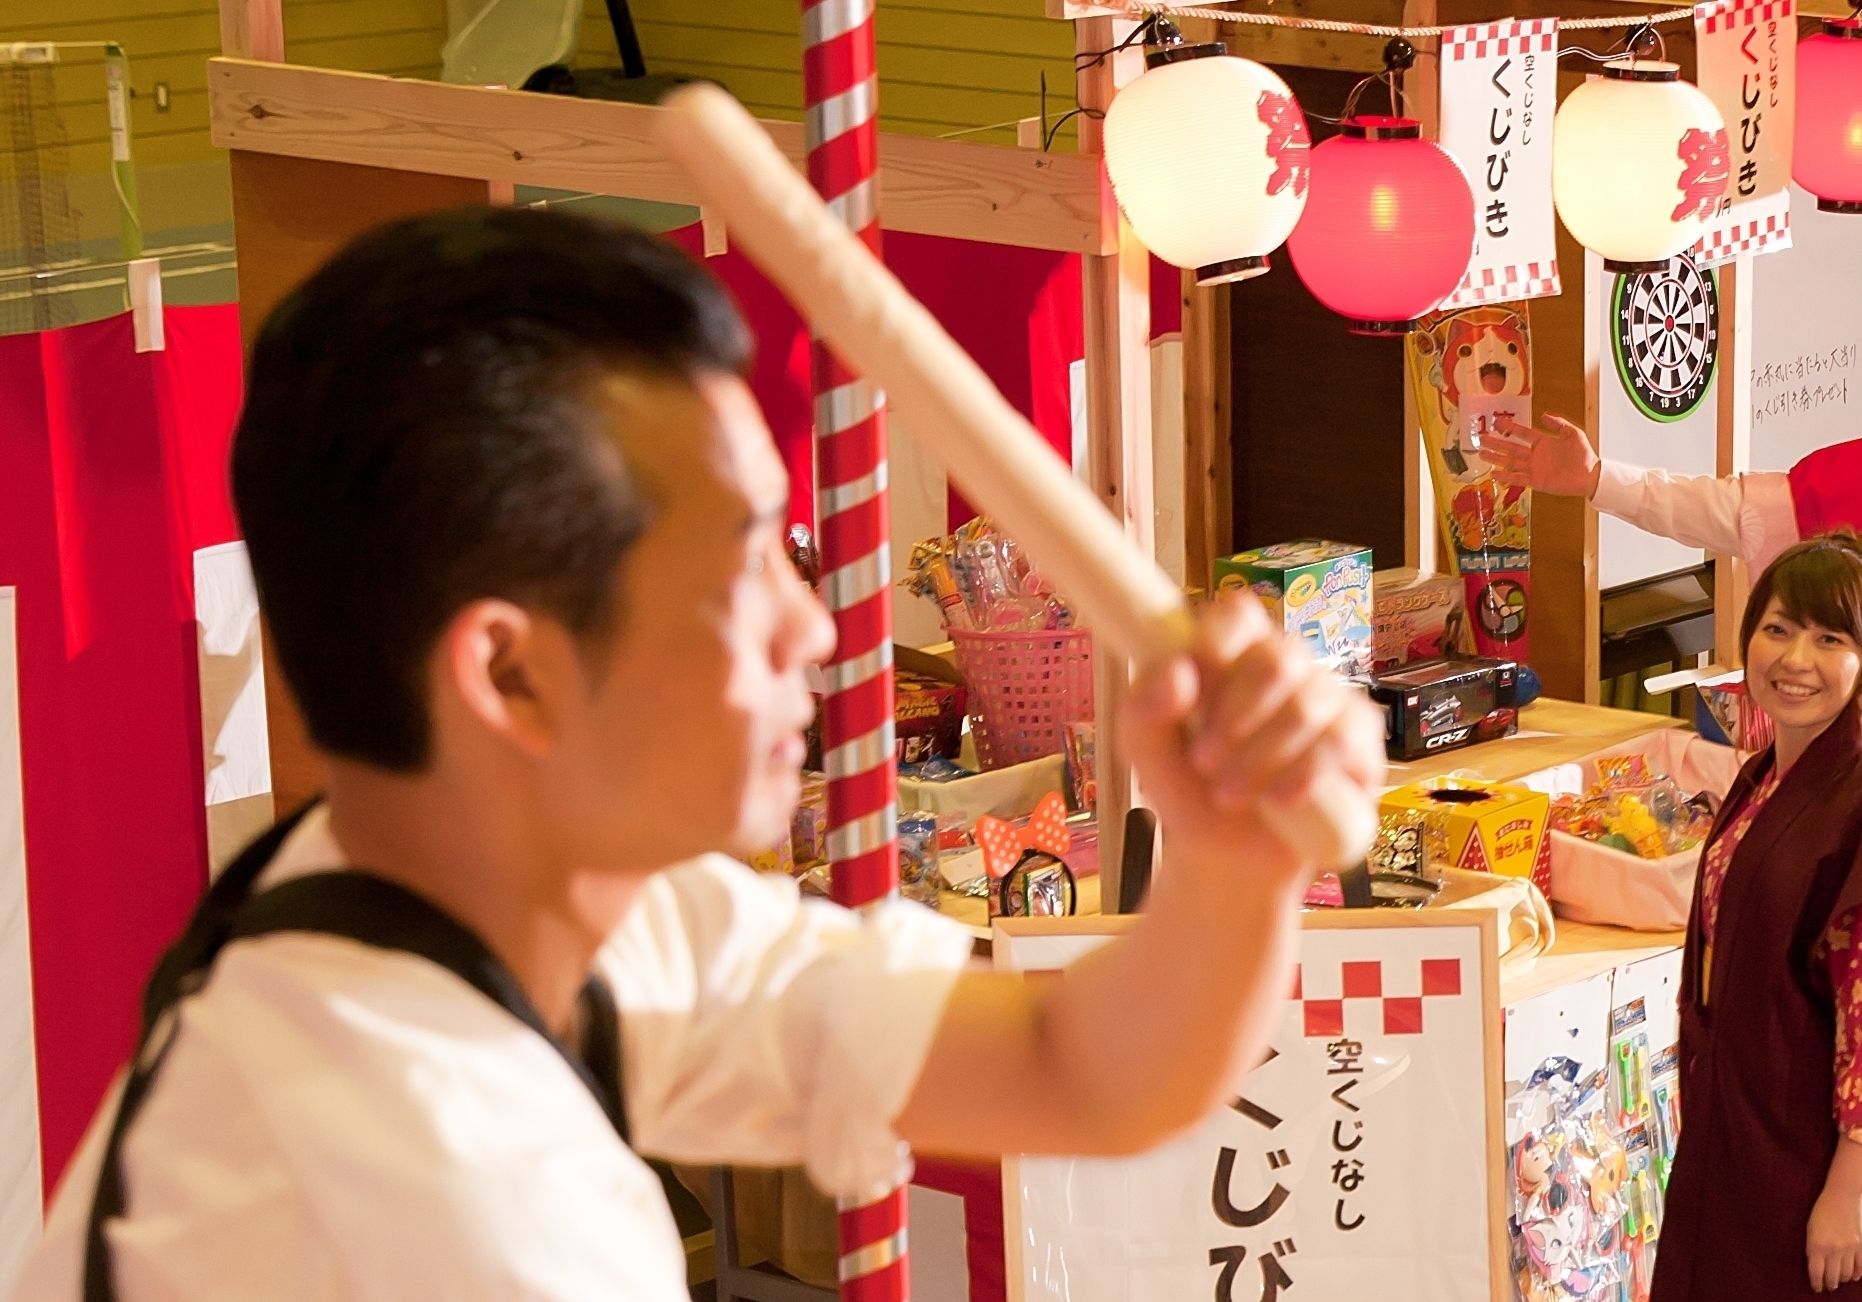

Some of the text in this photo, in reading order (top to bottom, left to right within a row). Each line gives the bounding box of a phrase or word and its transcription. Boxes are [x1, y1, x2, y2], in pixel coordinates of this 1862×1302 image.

[1486, 57, 1511, 238] くじびき
[1522, 54, 1535, 146] 空くじなし
[1738, 26, 1761, 196] くじびき
[1426, 727, 1470, 749] CR-Z
[1327, 1038, 1366, 1231] 空くじなし
